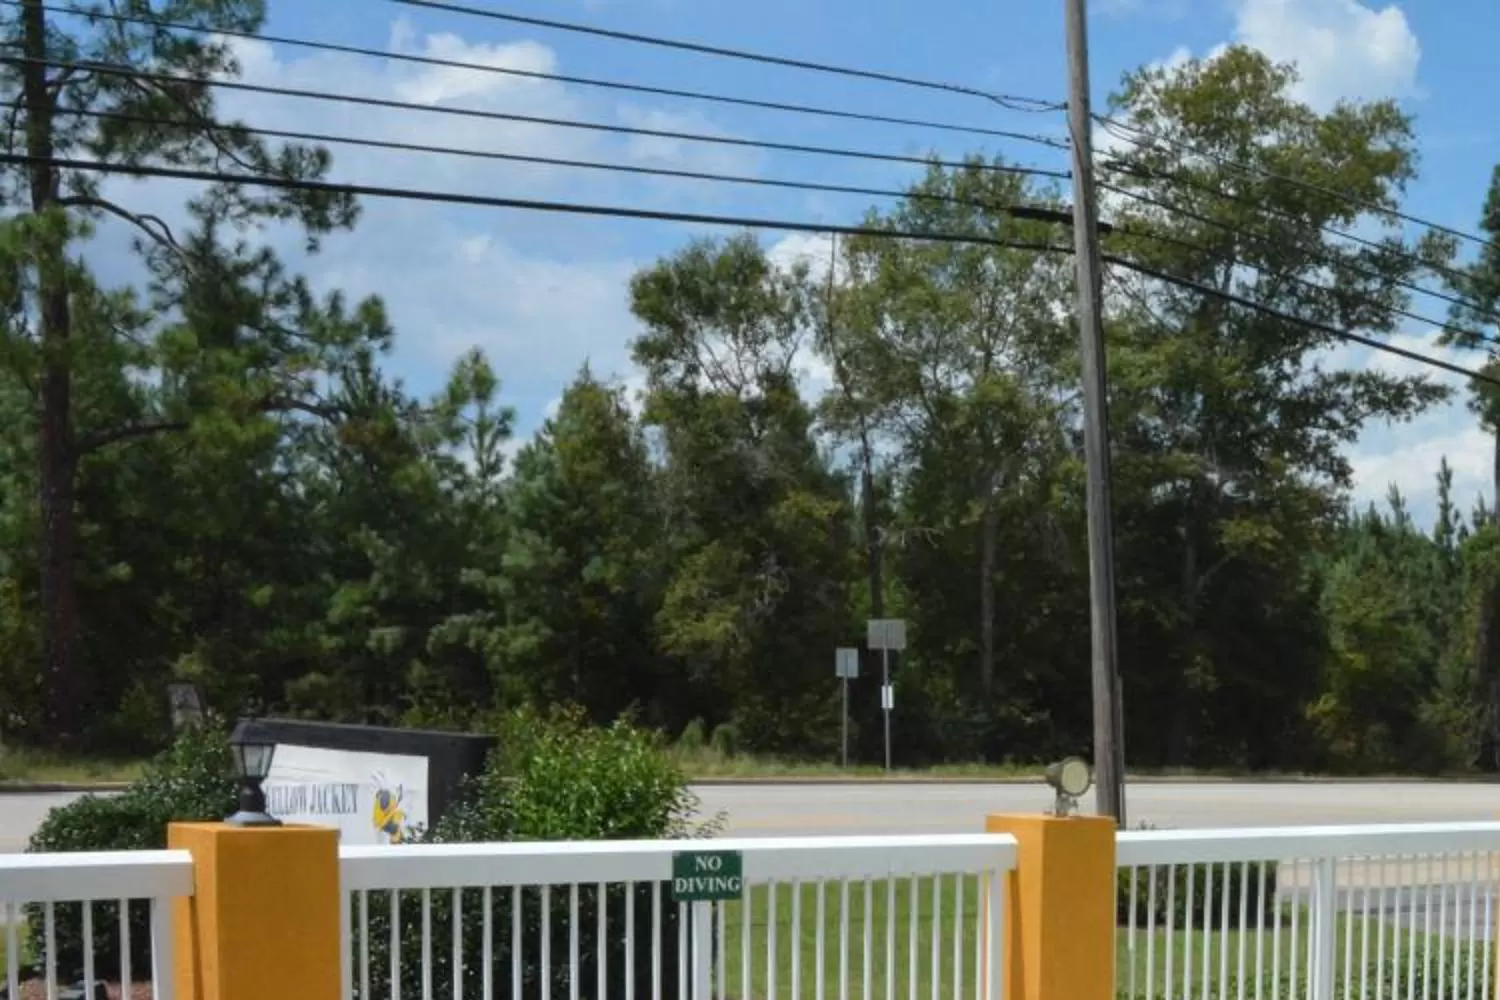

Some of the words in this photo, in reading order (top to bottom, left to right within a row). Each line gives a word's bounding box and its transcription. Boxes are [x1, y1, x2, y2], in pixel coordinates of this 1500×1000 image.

[310, 783, 359, 815] JACKET
[695, 855, 723, 872] NO
[675, 875, 742, 893] DIVING
